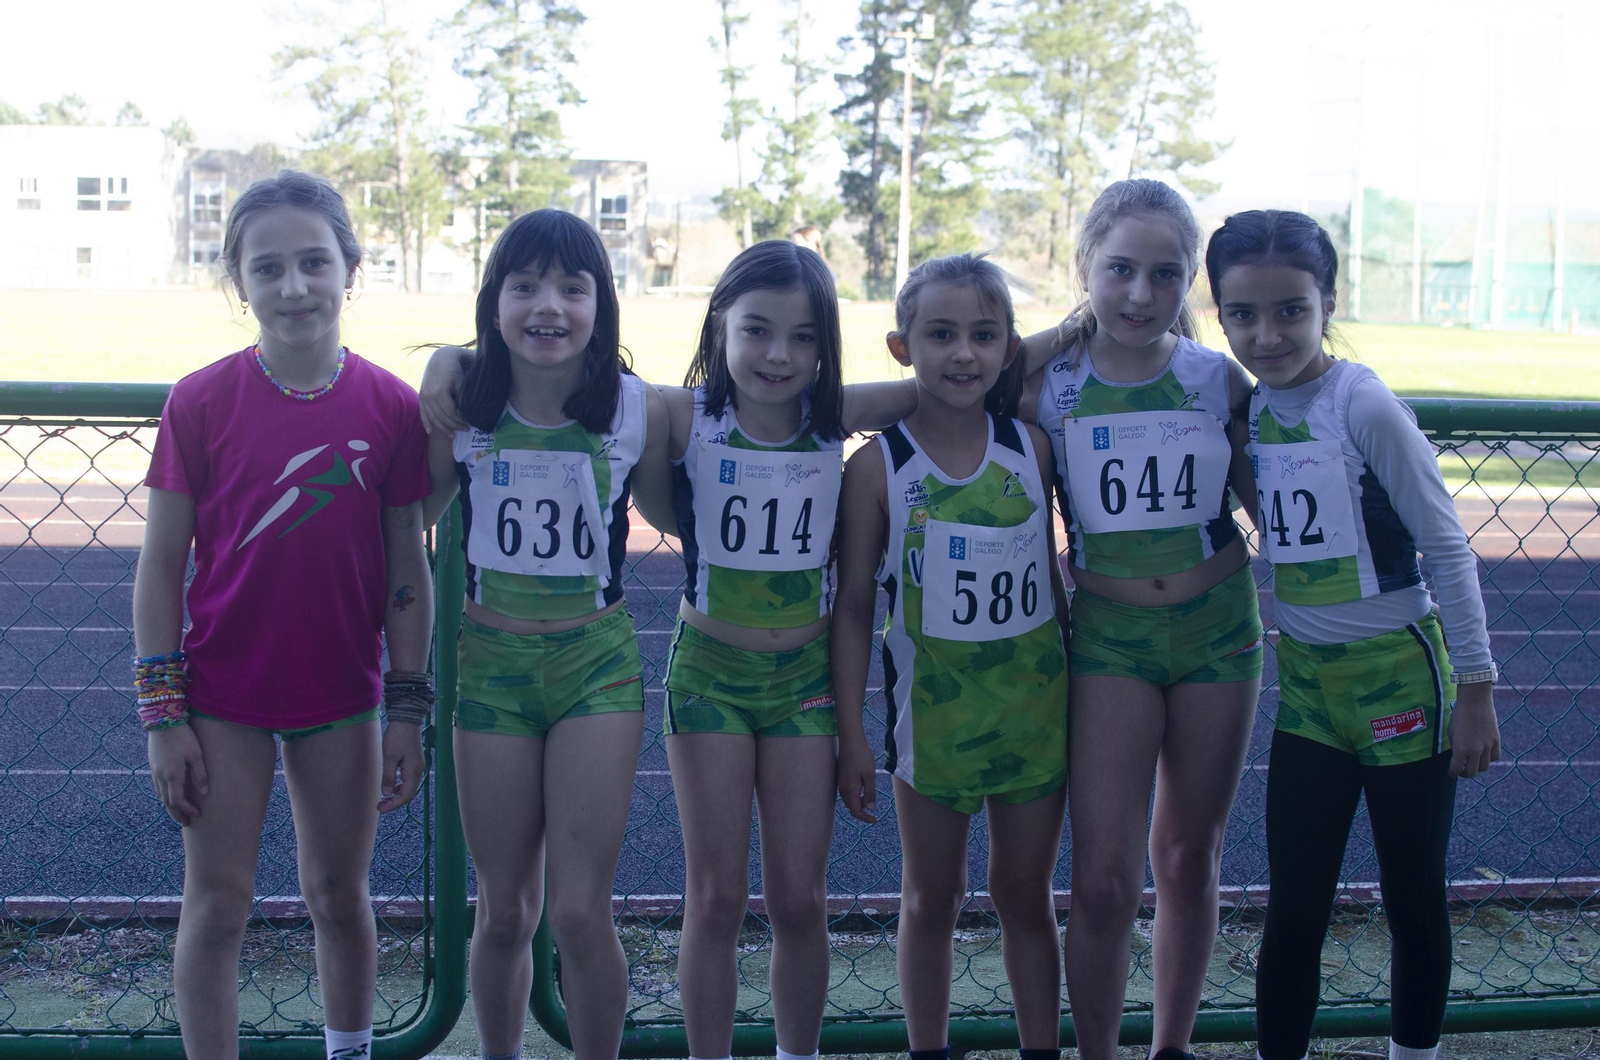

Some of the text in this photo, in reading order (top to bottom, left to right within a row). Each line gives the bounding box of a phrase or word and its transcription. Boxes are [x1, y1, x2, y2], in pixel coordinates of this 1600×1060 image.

[1118, 425, 1148, 433] DEPORTE
[1118, 432, 1146, 440] GALEGO
[519, 464, 551, 472] DEPORTE
[745, 465, 776, 473] DEPORTE
[744, 472, 773, 480] GALEGO
[1100, 454, 1198, 515] 644
[497, 497, 596, 561] 636
[720, 495, 813, 555] 614
[975, 540, 1005, 548] DEPORTE
[974, 547, 1002, 555] GALEGO
[952, 561, 1038, 625] 586
[1372, 711, 1422, 729] mandarina
[1374, 727, 1397, 738] home
